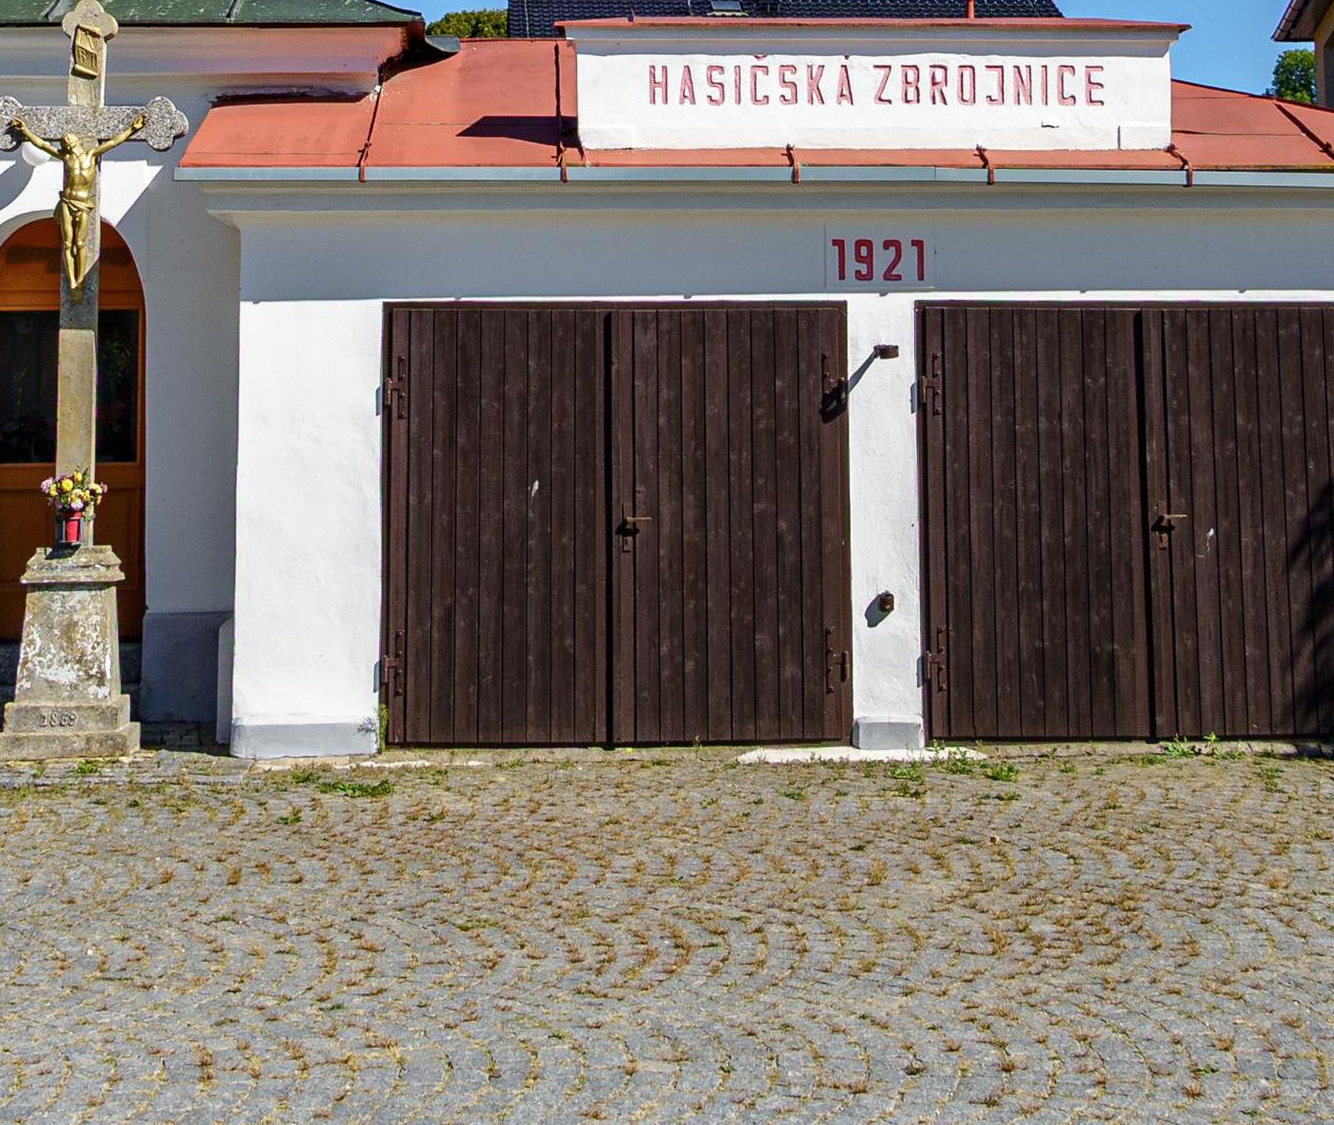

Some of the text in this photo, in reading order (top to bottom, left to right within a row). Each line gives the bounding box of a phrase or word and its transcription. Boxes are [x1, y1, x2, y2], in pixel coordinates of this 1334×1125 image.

[648, 54, 1105, 106] HASIČSKÁ ZBROJNICE
[831, 238, 925, 282] 1921
